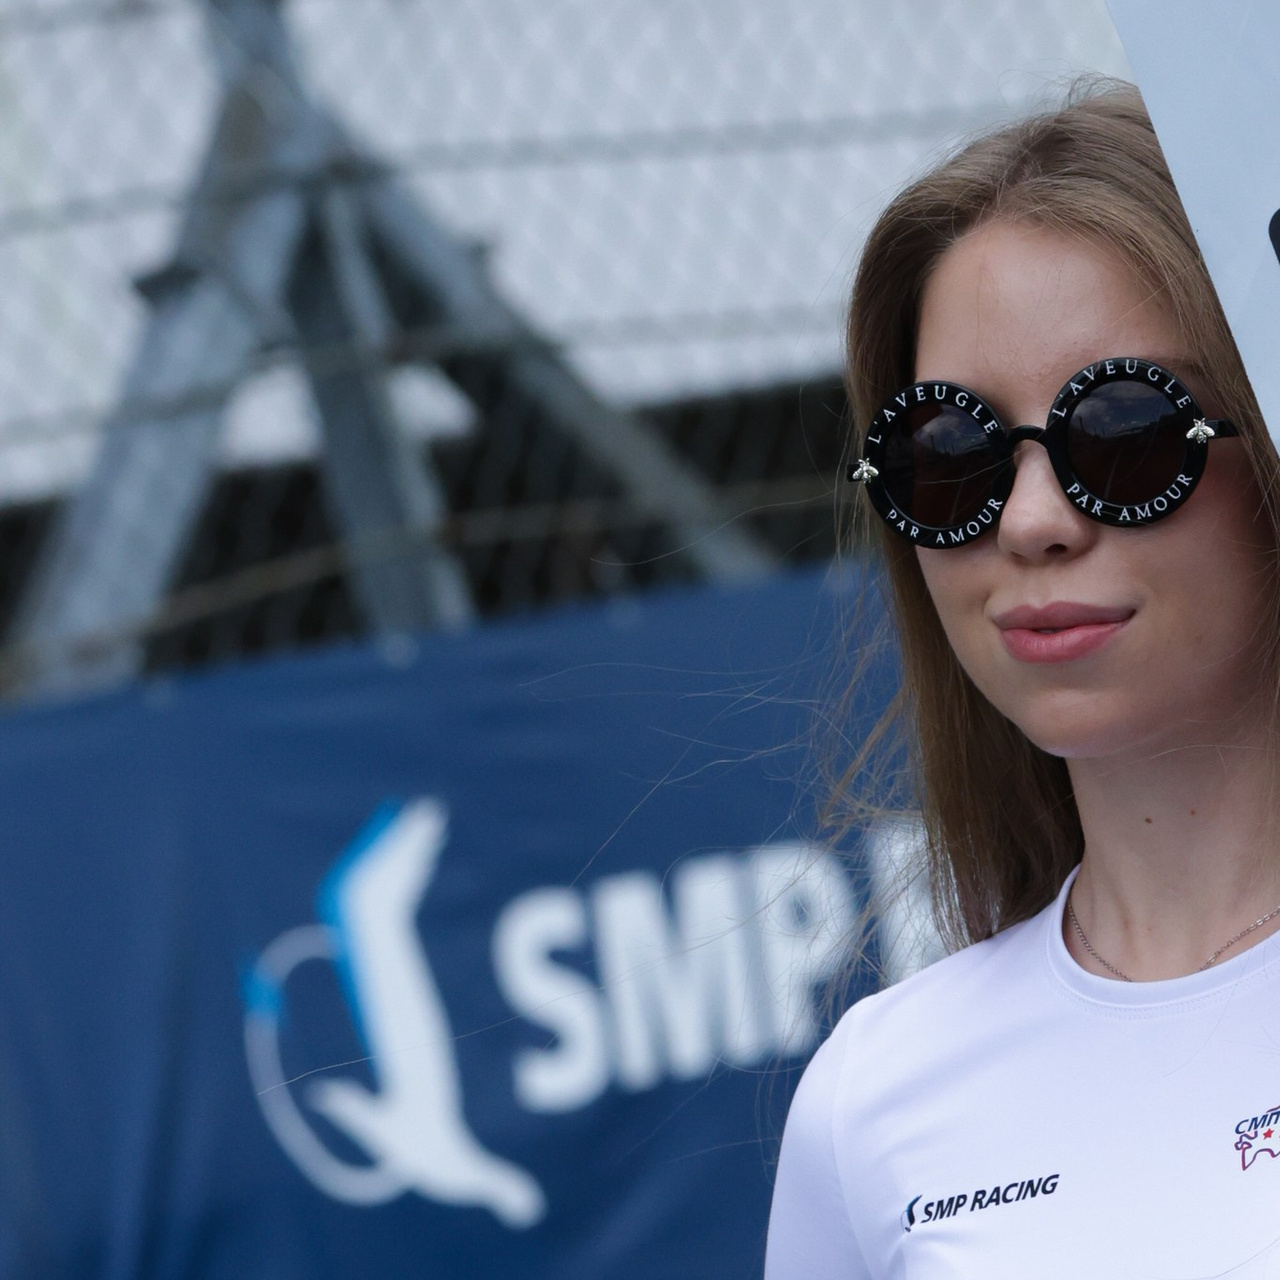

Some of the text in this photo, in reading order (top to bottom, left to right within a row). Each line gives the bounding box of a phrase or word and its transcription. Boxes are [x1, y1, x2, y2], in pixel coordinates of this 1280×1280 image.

[867, 385, 999, 446] L'AVEUGLE
[1051, 358, 1192, 419] L'AVEUGLE
[885, 496, 1004, 545] PAR AMOUR
[1066, 472, 1194, 522] PAR AMOUR
[493, 838, 862, 1113] SMP
[921, 1173, 1060, 1224] SMP RACING
